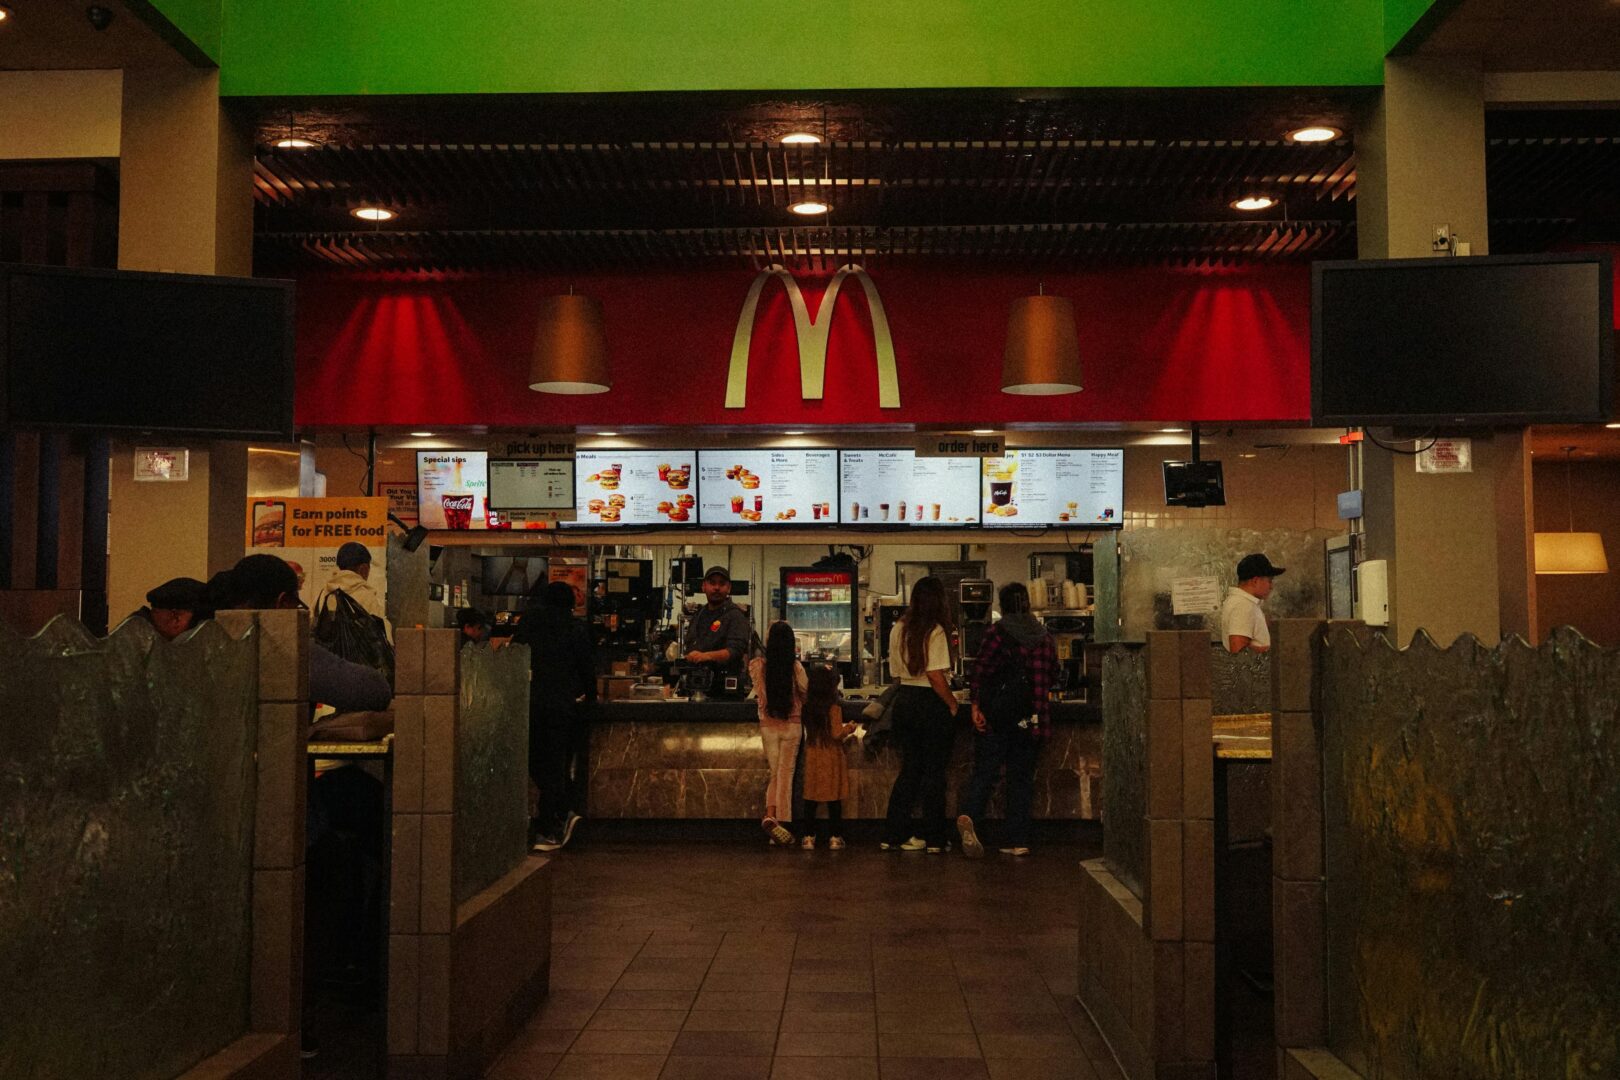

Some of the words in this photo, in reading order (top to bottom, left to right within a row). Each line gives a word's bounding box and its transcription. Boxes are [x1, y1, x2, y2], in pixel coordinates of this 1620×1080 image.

[506, 441, 530, 457] pick
[533, 444, 546, 457] up
[549, 441, 574, 454] here
[938, 440, 970, 453] order
[973, 440, 999, 453] here
[423, 456, 450, 464] Special
[452, 456, 467, 464] sips
[293, 509, 323, 519] Earn
[326, 508, 368, 522] points
[292, 525, 311, 537] for
[314, 525, 352, 536] FREE
[355, 524, 384, 536] food
